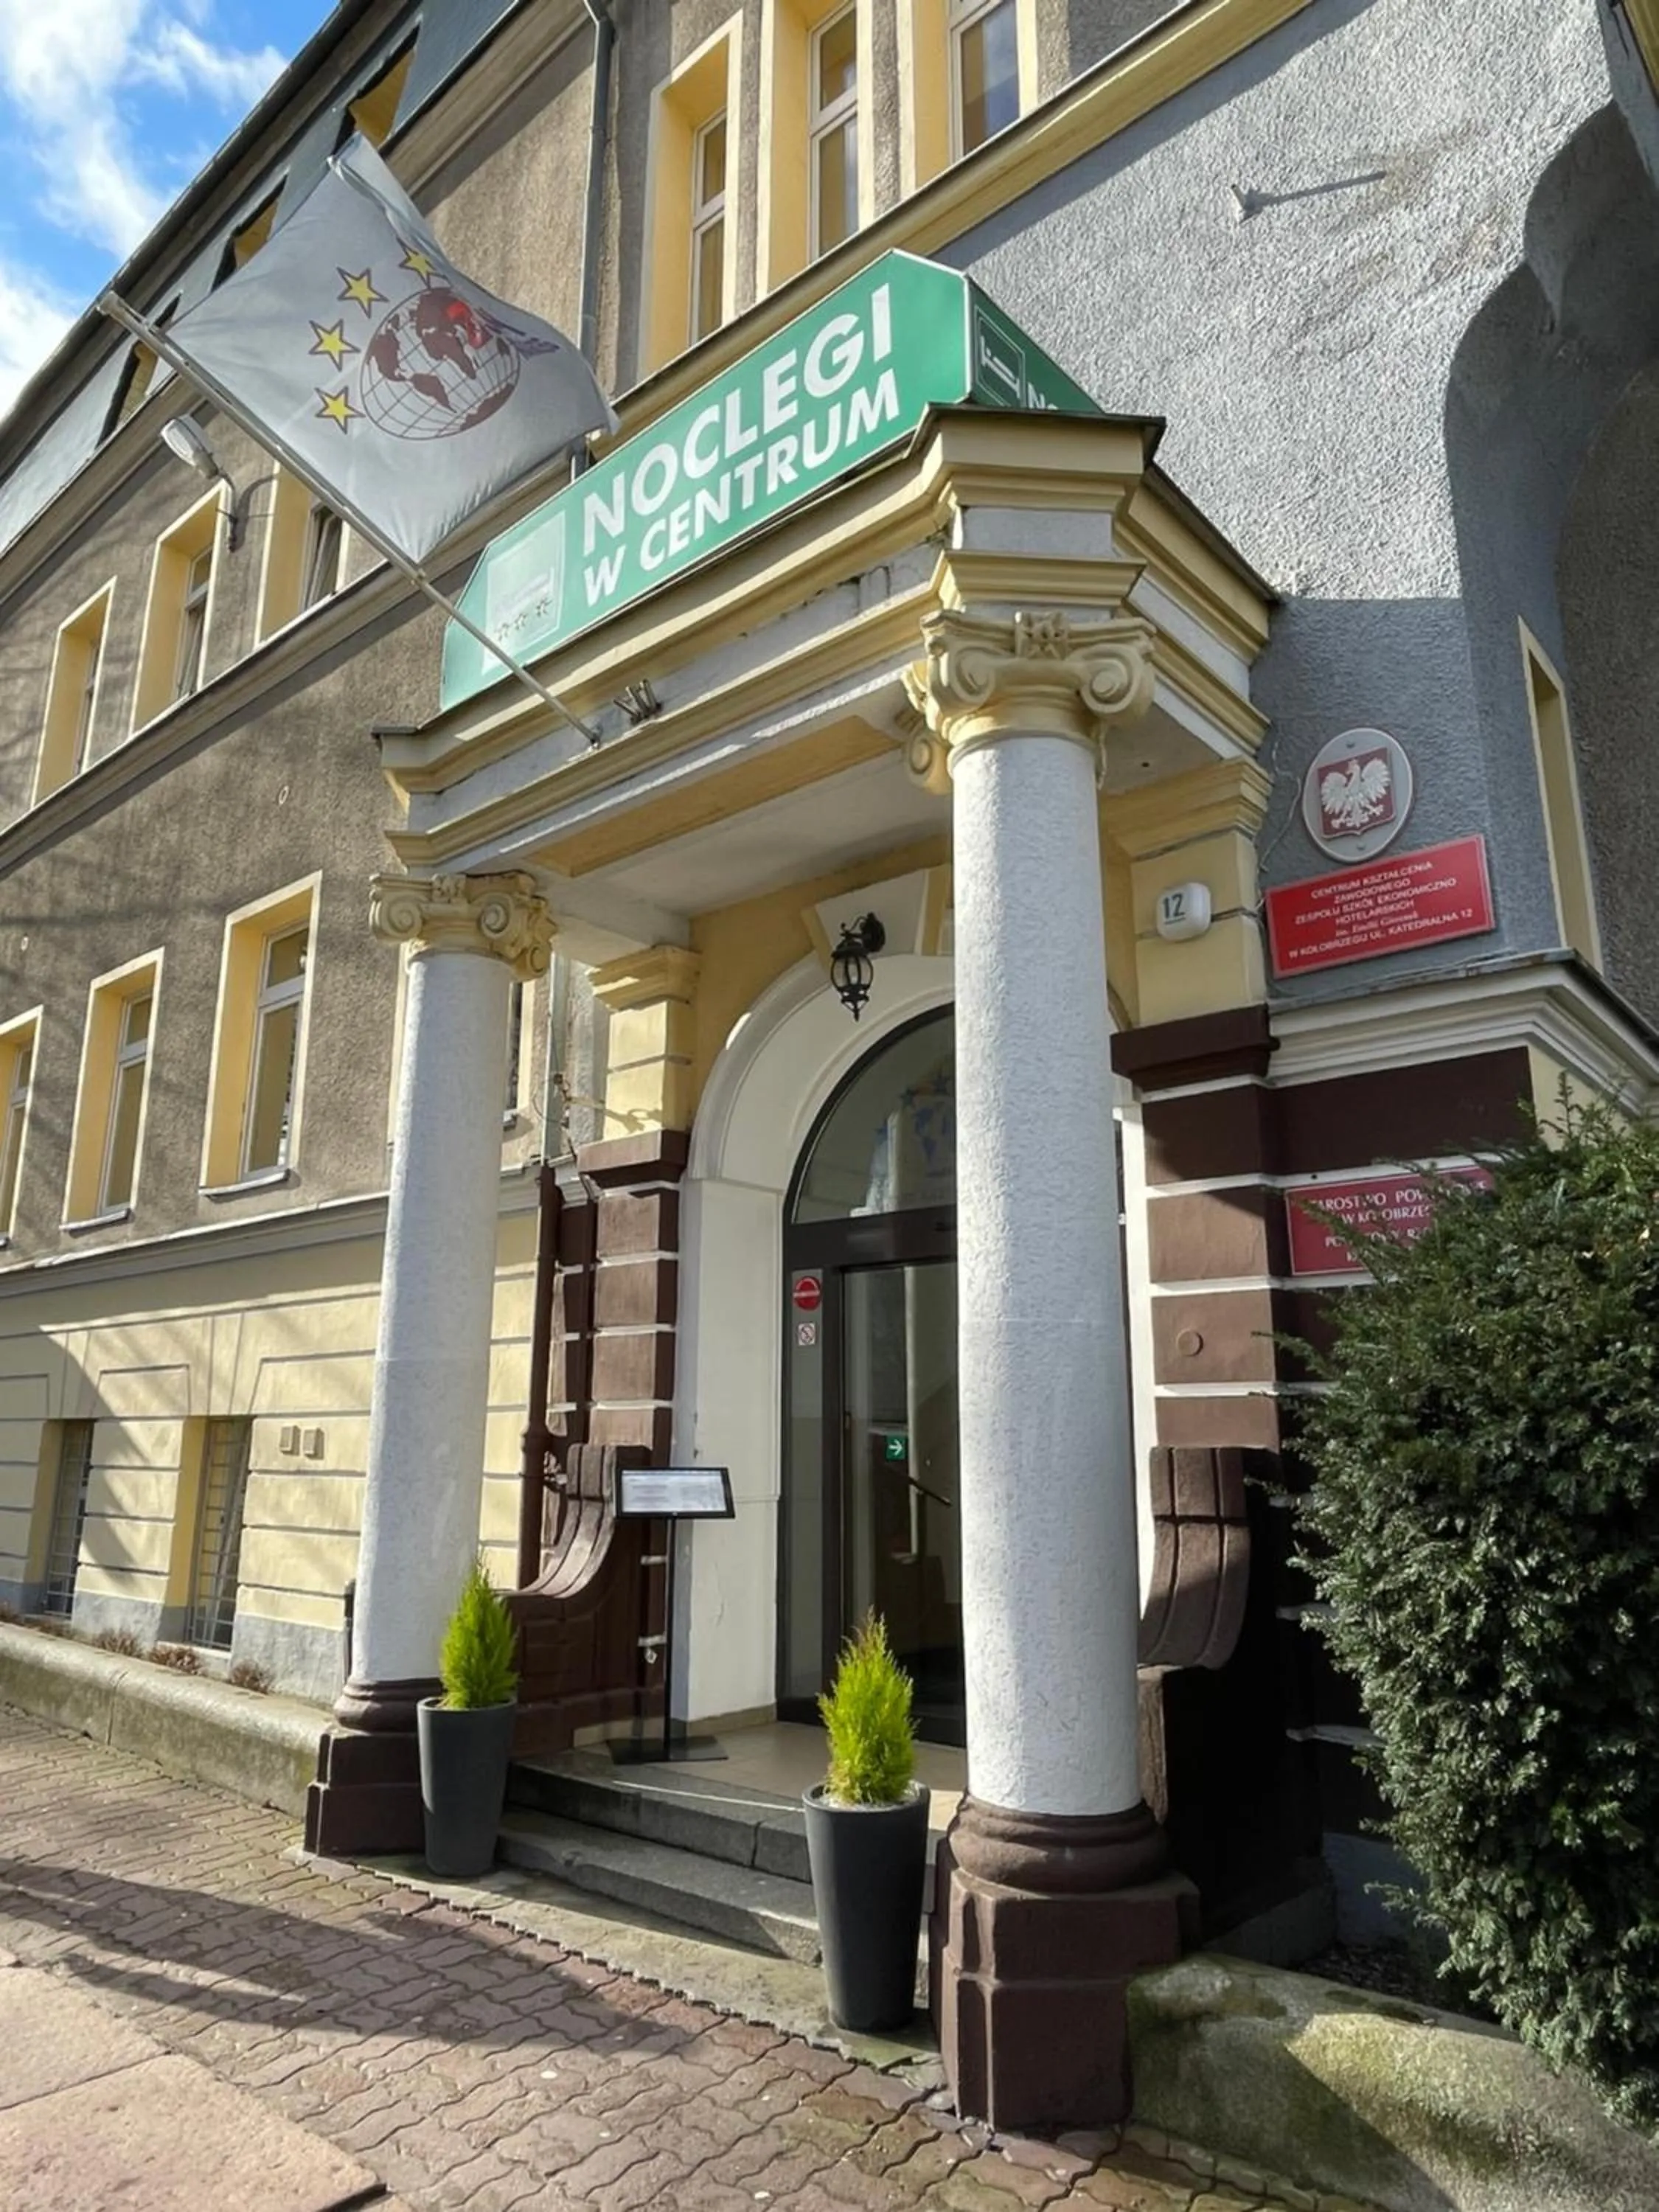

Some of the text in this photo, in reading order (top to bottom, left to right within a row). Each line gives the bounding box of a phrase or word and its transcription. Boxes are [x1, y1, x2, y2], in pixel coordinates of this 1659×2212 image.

[582, 282, 892, 557] NOCLEGI
[582, 369, 900, 607] W CENTRUM
[1311, 880, 1360, 898] CENTRUM
[1334, 877, 1411, 904] ZAWODOWEGO
[1164, 893, 1185, 919] 12
[1335, 900, 1414, 925] HOTELARSKICH
[1388, 912, 1459, 935] KATEDRALNA
[1461, 908, 1473, 919] 12
